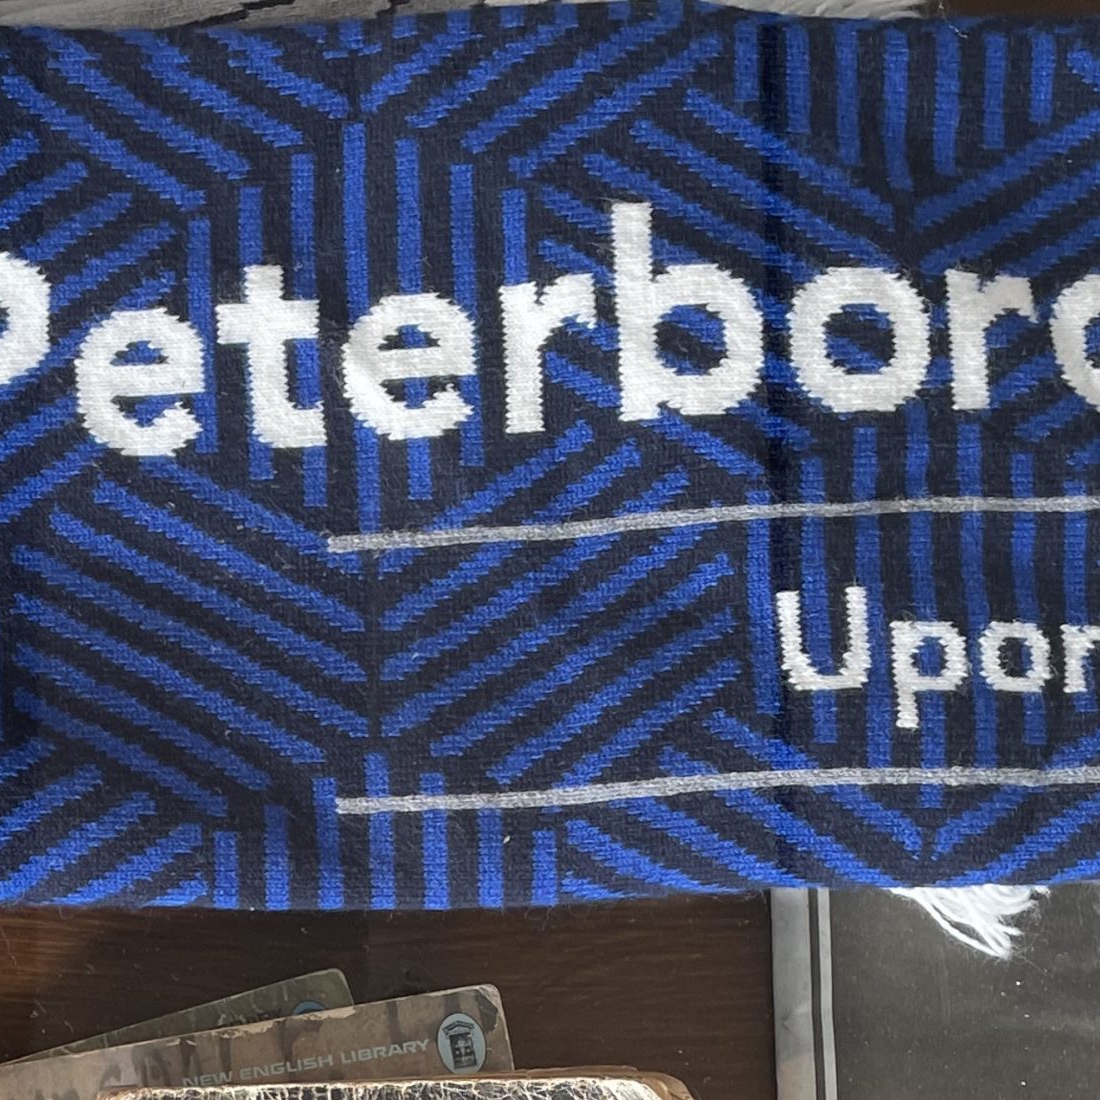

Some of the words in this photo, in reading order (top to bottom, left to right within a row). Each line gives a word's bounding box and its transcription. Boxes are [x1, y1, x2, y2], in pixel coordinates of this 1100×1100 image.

[182, 1070, 233, 1087] NEW
[240, 1054, 334, 1080] ENGLISH
[340, 1038, 430, 1063] LIBRARY
